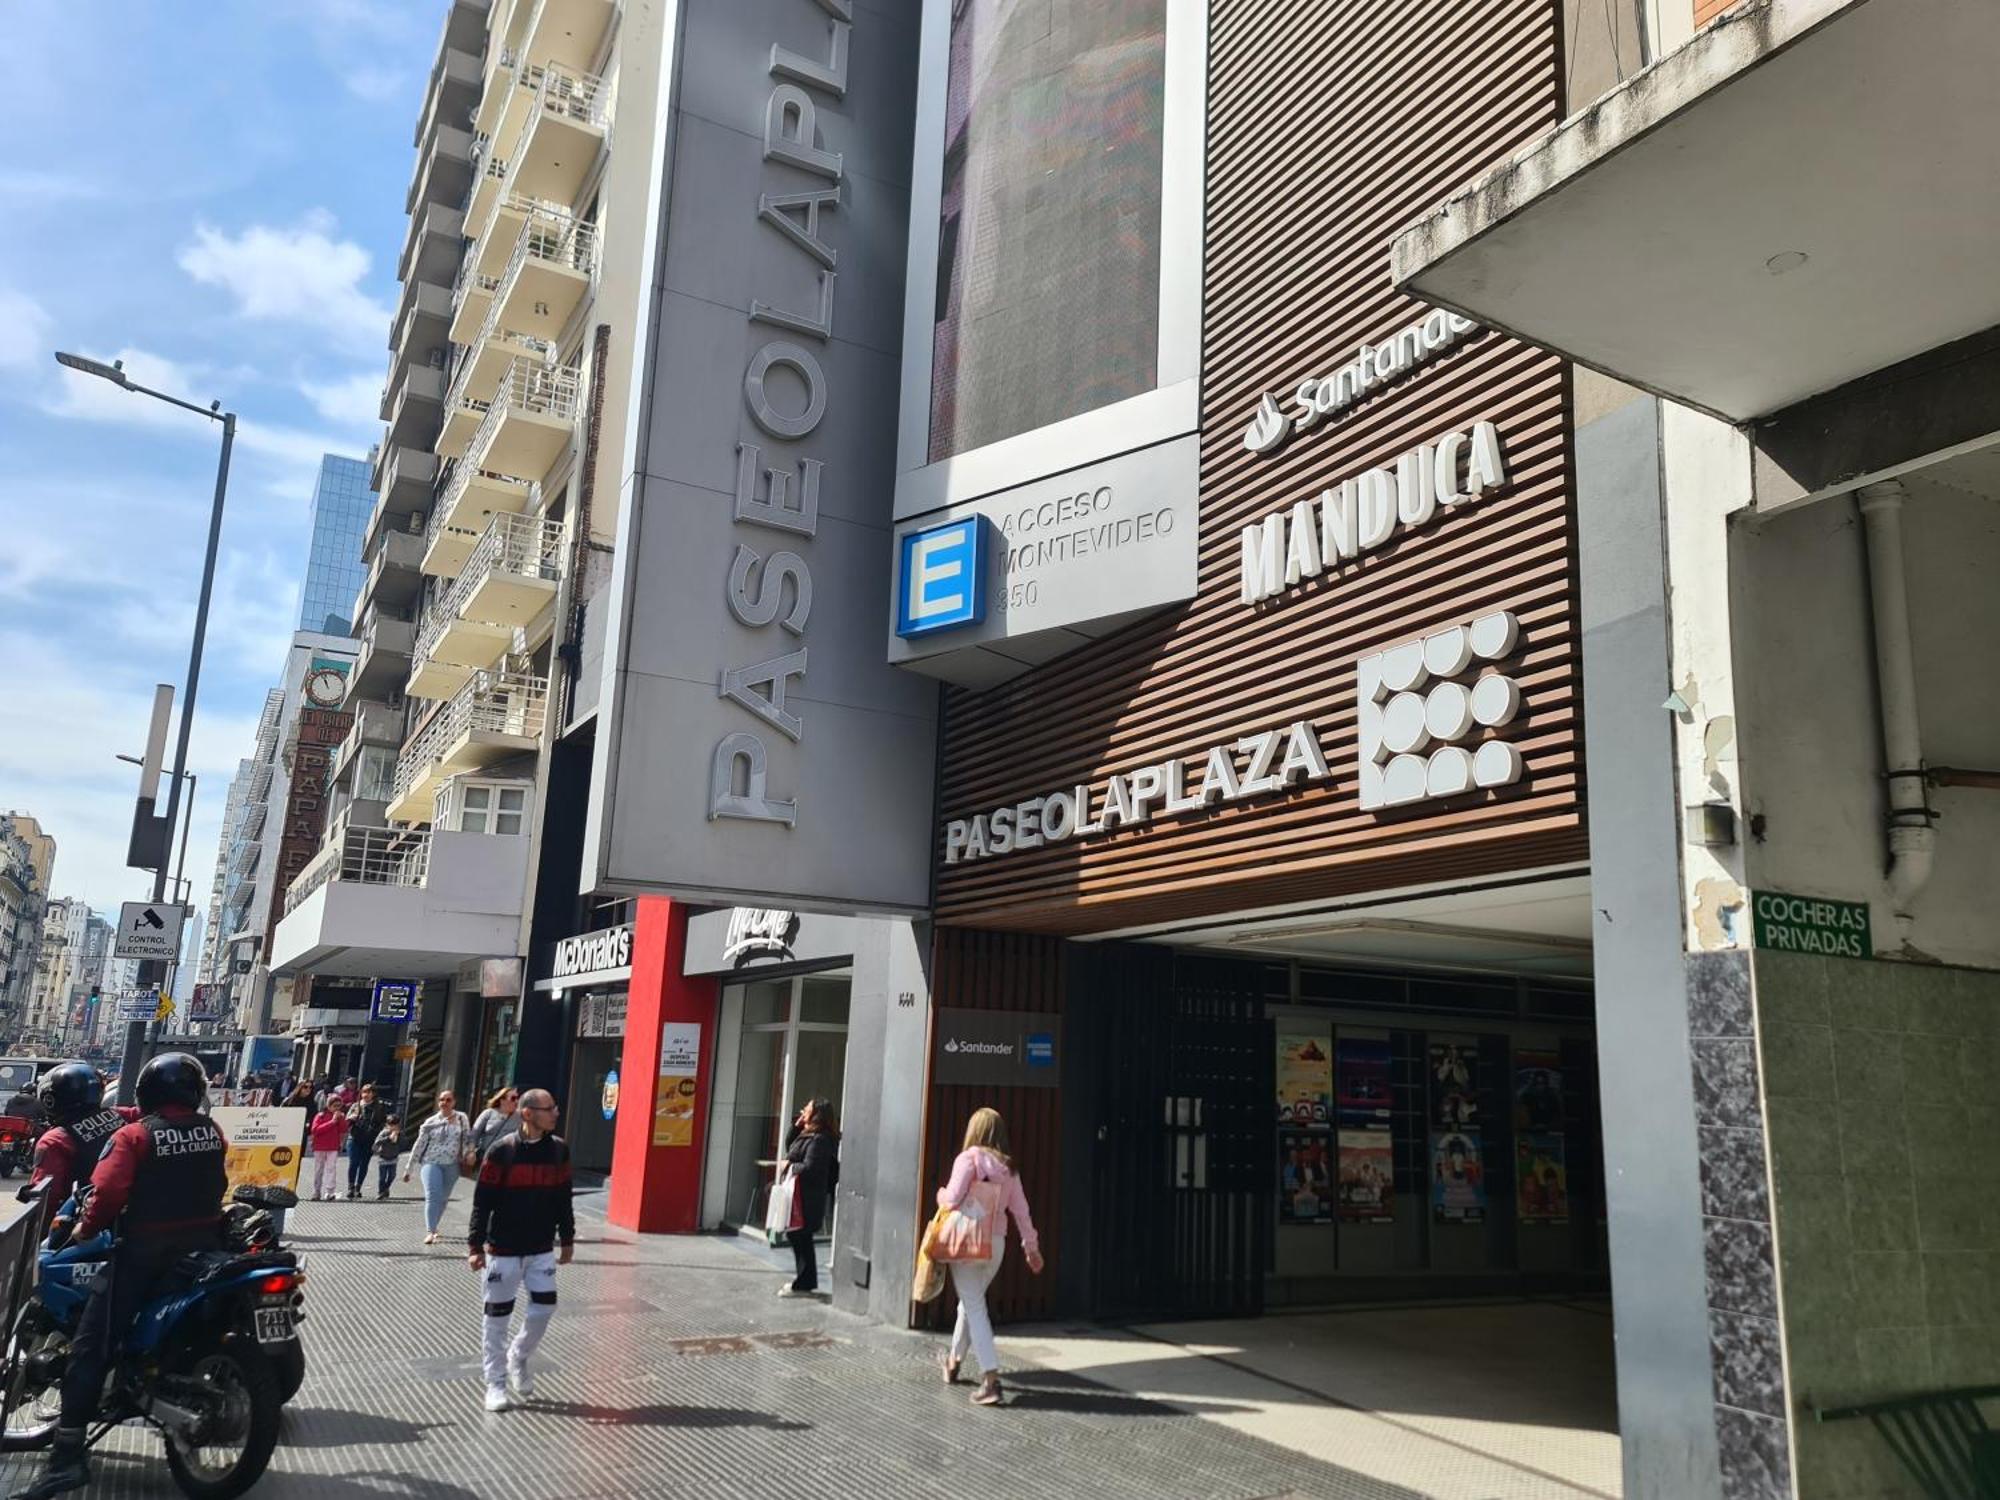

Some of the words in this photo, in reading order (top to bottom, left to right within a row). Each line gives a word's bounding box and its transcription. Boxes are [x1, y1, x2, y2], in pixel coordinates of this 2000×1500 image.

[1295, 307, 1478, 428] Santande
[708, 0, 853, 829] PASEOLAPL
[1000, 485, 1114, 540] ACCESO
[1241, 420, 1506, 606] MANDUCA
[997, 507, 1175, 578] MONTEVIDEO
[908, 529, 966, 621] E
[288, 754, 324, 838] PAPA
[944, 720, 1331, 864] PASEOLAPLAZA
[1758, 895, 1867, 931] COCHERAS
[117, 945, 174, 956] ELECTRONICO
[128, 936, 167, 944] CONTROL
[552, 927, 630, 977] McDonald's
[1765, 924, 1863, 958] PRIVADAS
[121, 990, 154, 998] TAROT
[959, 1040, 1014, 1055] Santander
[72, 1109, 121, 1136] POLICIA
[82, 1131, 95, 1142] DE
[154, 1125, 220, 1145] POLICIA
[157, 1144, 171, 1157] DE
[173, 1142, 187, 1154] LA
[188, 1140, 222, 1153] CIUDAD
